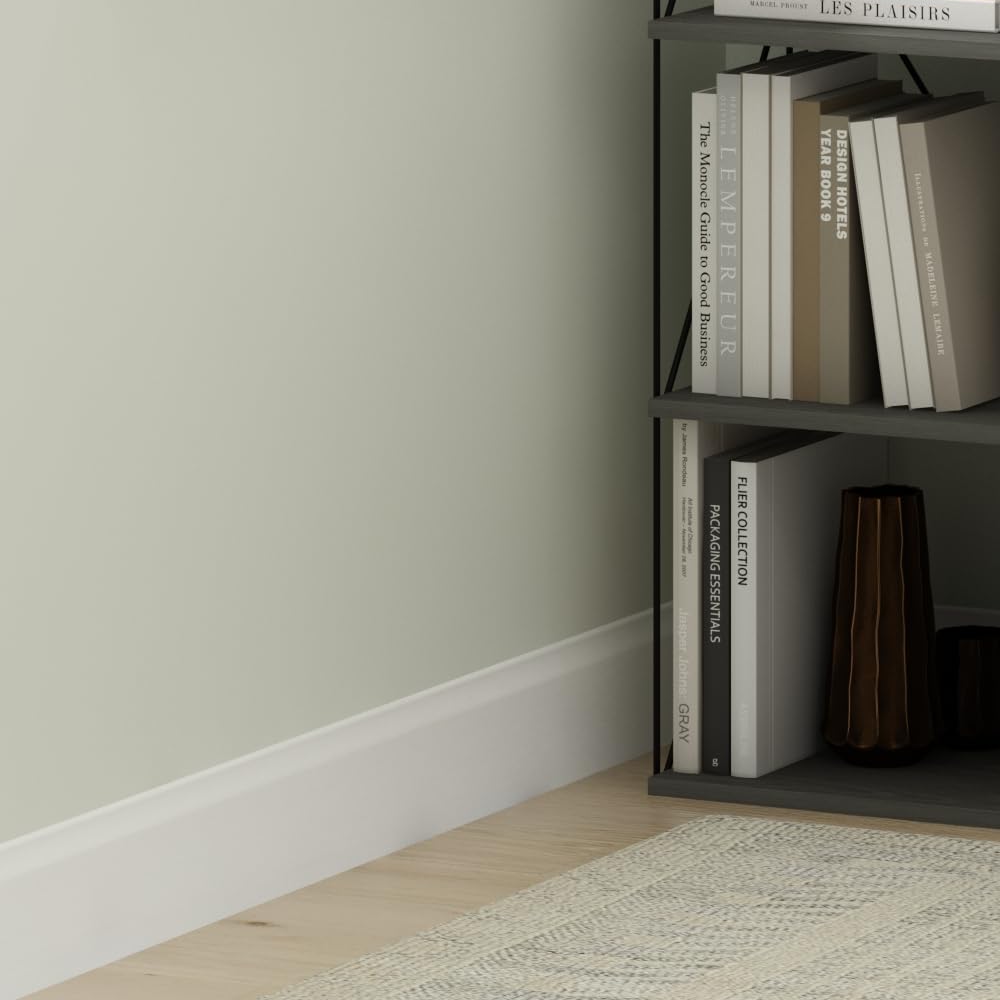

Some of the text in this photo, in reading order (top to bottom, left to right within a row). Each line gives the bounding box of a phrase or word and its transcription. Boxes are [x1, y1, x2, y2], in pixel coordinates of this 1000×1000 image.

[750, 0, 777, 8] MARCEL
[820, 0, 951, 22] LES PLAISIRS
[820, 128, 832, 222] YEAR BOOK 9
[836, 129, 848, 240] DESIGN HOTELS
[699, 121, 711, 367] The Monocle Guide to Good Business
[719, 145, 737, 358] LEMPEREUR
[924, 252, 939, 307] MADELEINE
[681, 423, 687, 432] by
[737, 476, 748, 587] FLIER COLLECTION
[709, 504, 721, 644] PACKAGING ESSENTIALS
[677, 607, 689, 651] Jasper
[678, 703, 690, 744] GRAY
